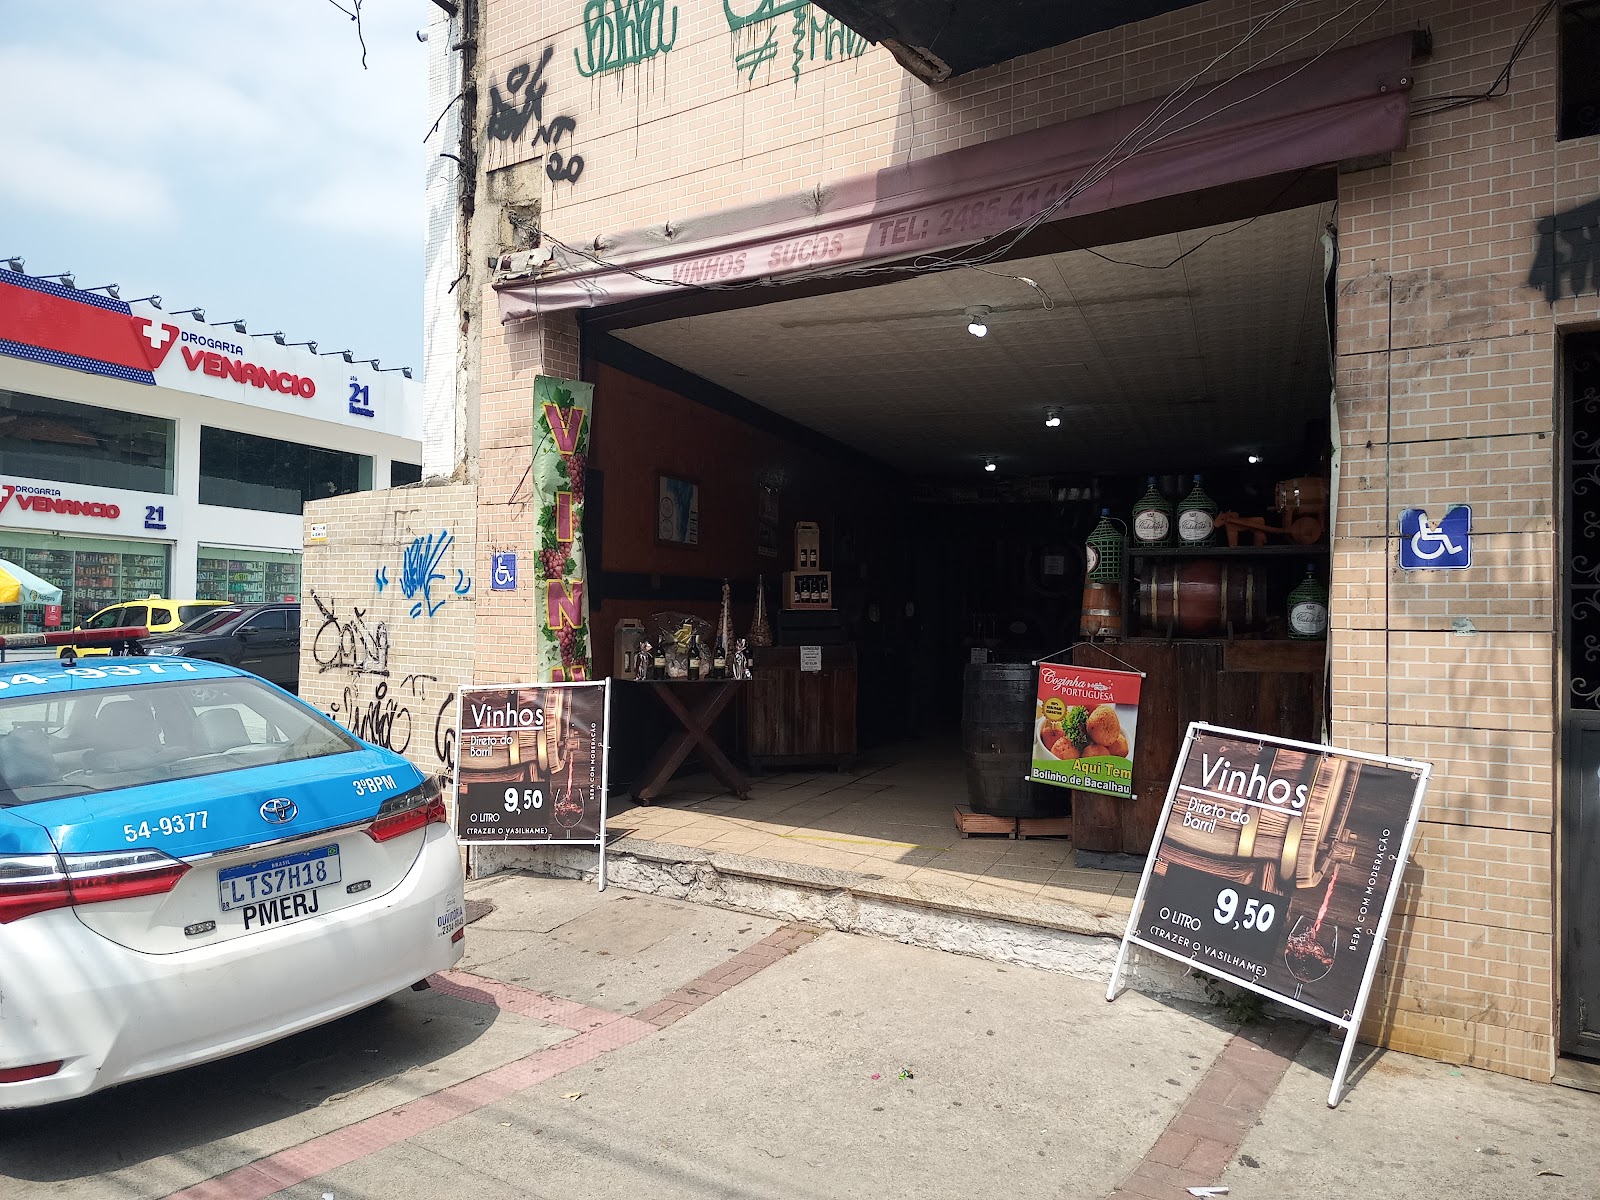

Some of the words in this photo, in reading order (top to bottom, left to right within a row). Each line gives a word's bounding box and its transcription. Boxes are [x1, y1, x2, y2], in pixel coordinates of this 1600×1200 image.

[672, 252, 748, 284] VINHOS
[768, 232, 844, 271] SUCOS
[878, 214, 928, 248] TEL:
[181, 331, 243, 356] DROGARIA
[181, 346, 316, 399] VENANCIO
[348, 382, 369, 406] 21
[15, 485, 61, 497] DROGARIA
[15, 494, 121, 519] VENANCIO
[145, 505, 164, 522] 21
[1041, 667, 1088, 692] Cozinha
[1061, 687, 1114, 702] PORTUGUESA
[470, 702, 545, 728] Vinhos
[469, 735, 497, 746] Direto
[500, 735, 514, 746] do
[469, 746, 494, 757] Barril
[1032, 768, 1067, 783] Bolinho
[1069, 775, 1082, 786] de
[1084, 777, 1131, 794] Bacalhau
[1072, 758, 1102, 775] Aqui
[1104, 763, 1132, 780] Tem
[1200, 753, 1309, 809] Vinhos
[503, 786, 544, 815] 9,50
[1186, 795, 1227, 822] Direto
[1230, 806, 1251, 826] do
[123, 810, 209, 843] 54-9377
[469, 813, 478, 823] O
[479, 812, 501, 823] LITRO
[1182, 811, 1217, 834] Barril
[466, 827, 496, 835] (TRAZER
[505, 826, 549, 835] VASILHAME)
[271, 860, 291, 869] BRASIL
[231, 860, 328, 903] LTS7H18
[1348, 928, 1364, 952] BEBA
[1357, 897, 1370, 924] COM
[1365, 827, 1391, 895] MODERAÇÃO
[243, 889, 319, 930] PMERJ
[1158, 906, 1171, 921] O
[1171, 910, 1202, 932] LITRO
[1213, 887, 1276, 932] 9,50
[1149, 925, 1191, 948] (TRAZER
[1192, 941, 1201, 952] O
[1203, 946, 1268, 978] VASILHAME)
